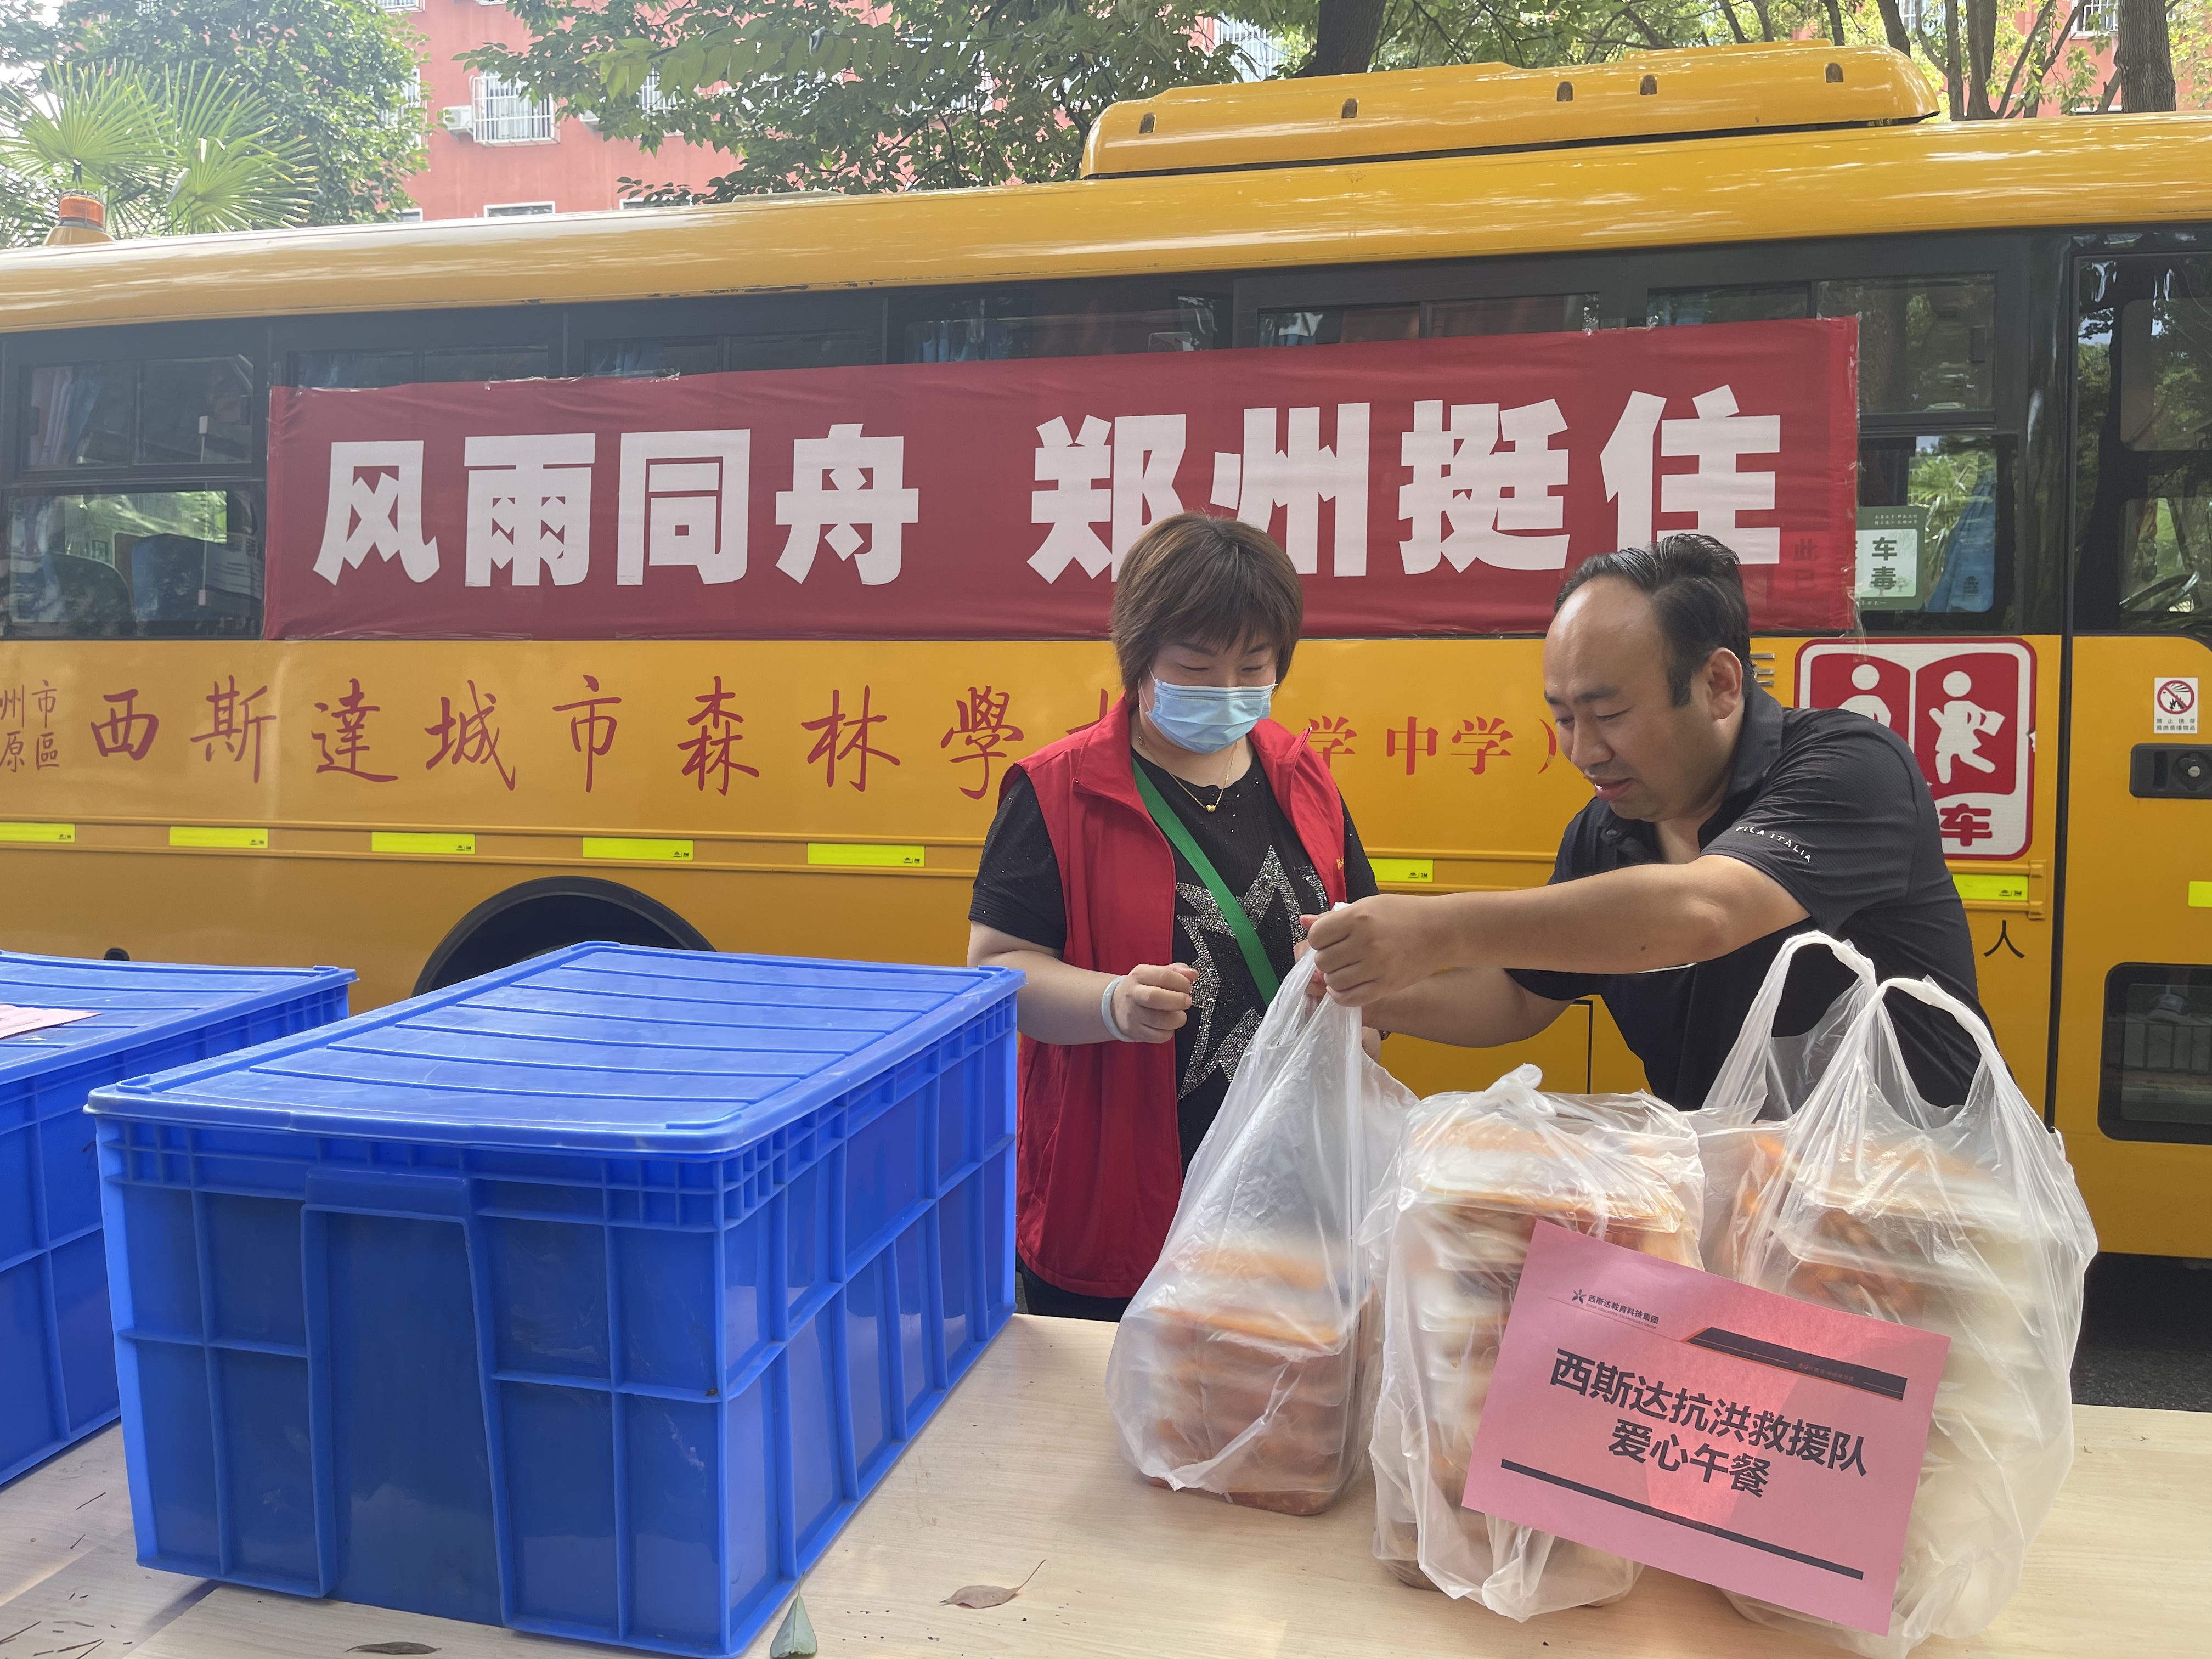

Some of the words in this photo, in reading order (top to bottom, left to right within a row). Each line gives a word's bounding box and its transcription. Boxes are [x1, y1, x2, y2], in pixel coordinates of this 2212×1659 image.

[313, 423, 919, 586] 风雨同舟
[1027, 384, 1781, 583] 郑州挺住
[90, 674, 1108, 800] 西斯達城市森林學
[1735, 826, 1765, 836] FILA
[1770, 833, 1811, 862] ITALIA
[1940, 803, 1993, 847] 车
[1983, 919, 2025, 959] 人
[1588, 1294, 1660, 1325] 西斯达教育科技集团
[1549, 1348, 1867, 1477] 西斯达抗洪救援队
[1608, 1418, 1771, 1498] 爱心午餐
